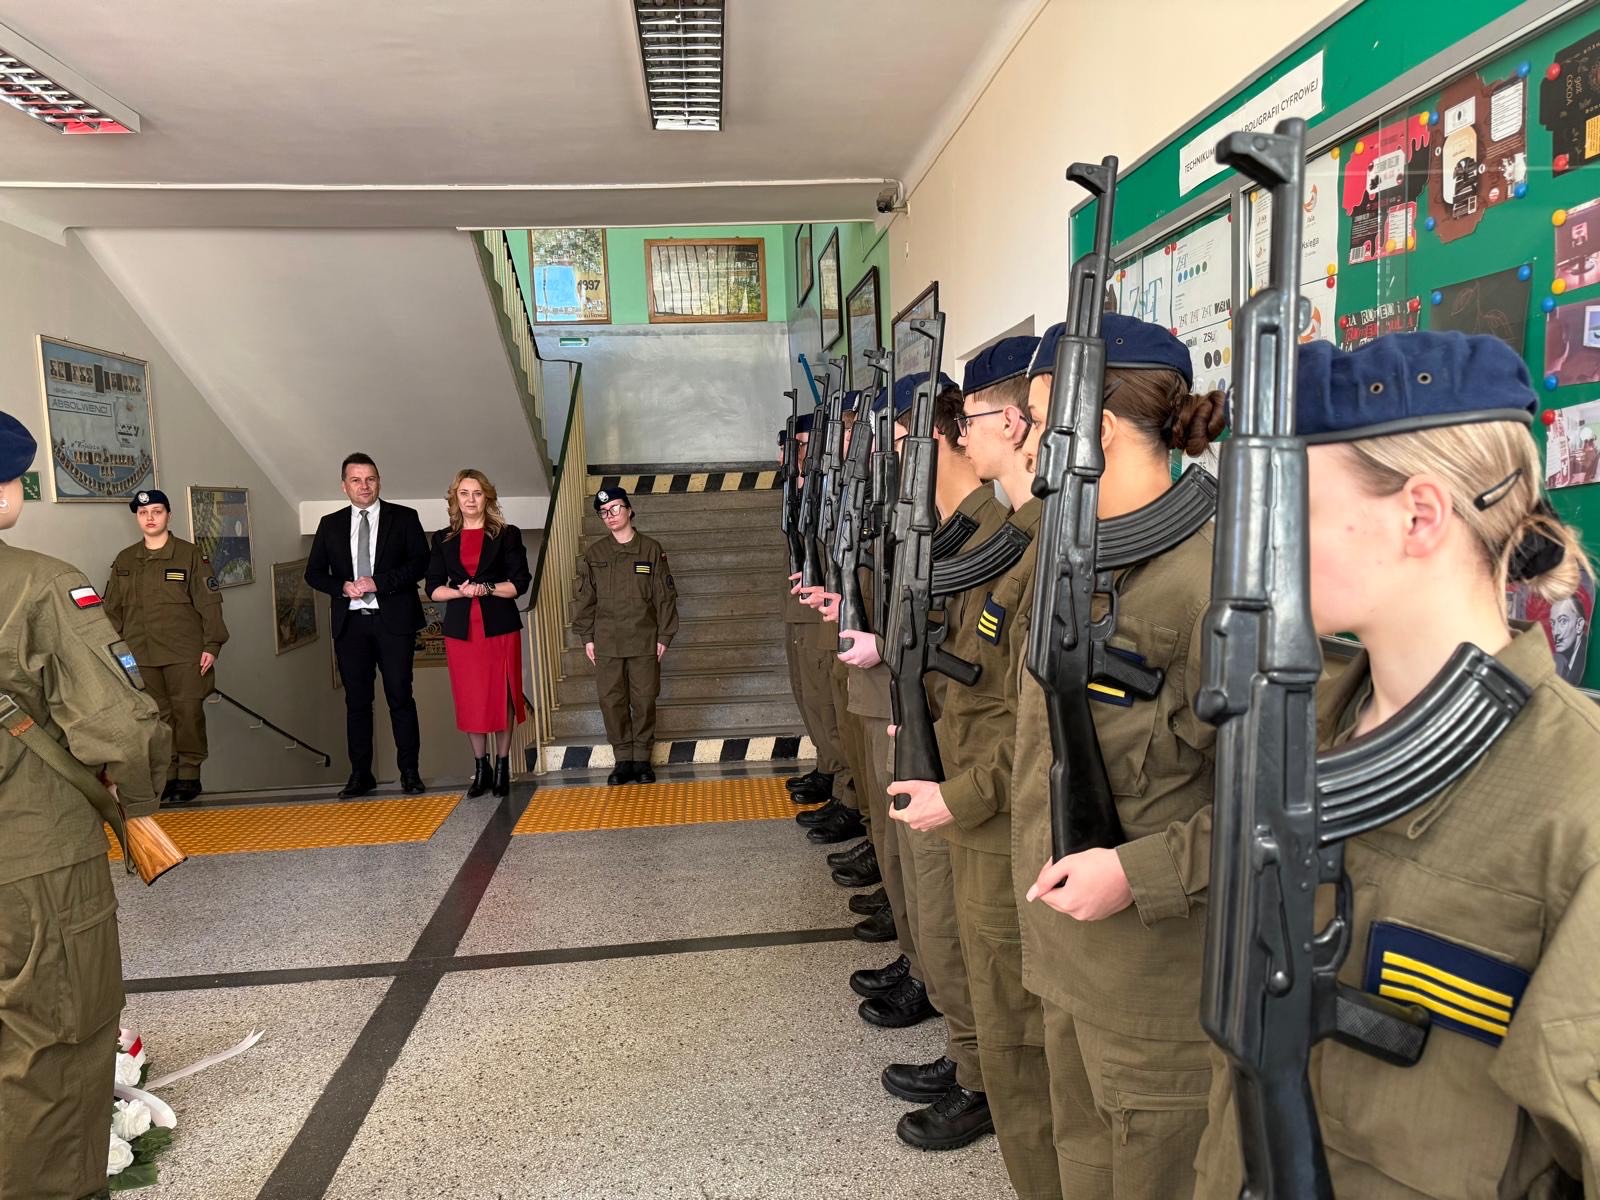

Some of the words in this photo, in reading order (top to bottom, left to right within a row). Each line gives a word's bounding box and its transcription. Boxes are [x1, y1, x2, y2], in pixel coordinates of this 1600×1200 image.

[1244, 103, 1280, 132] POLIGRAFII
[1280, 78, 1319, 111] CYFROWEJ
[577, 279, 601, 291] 1997
[52, 398, 108, 414] ABSOLWENCI
